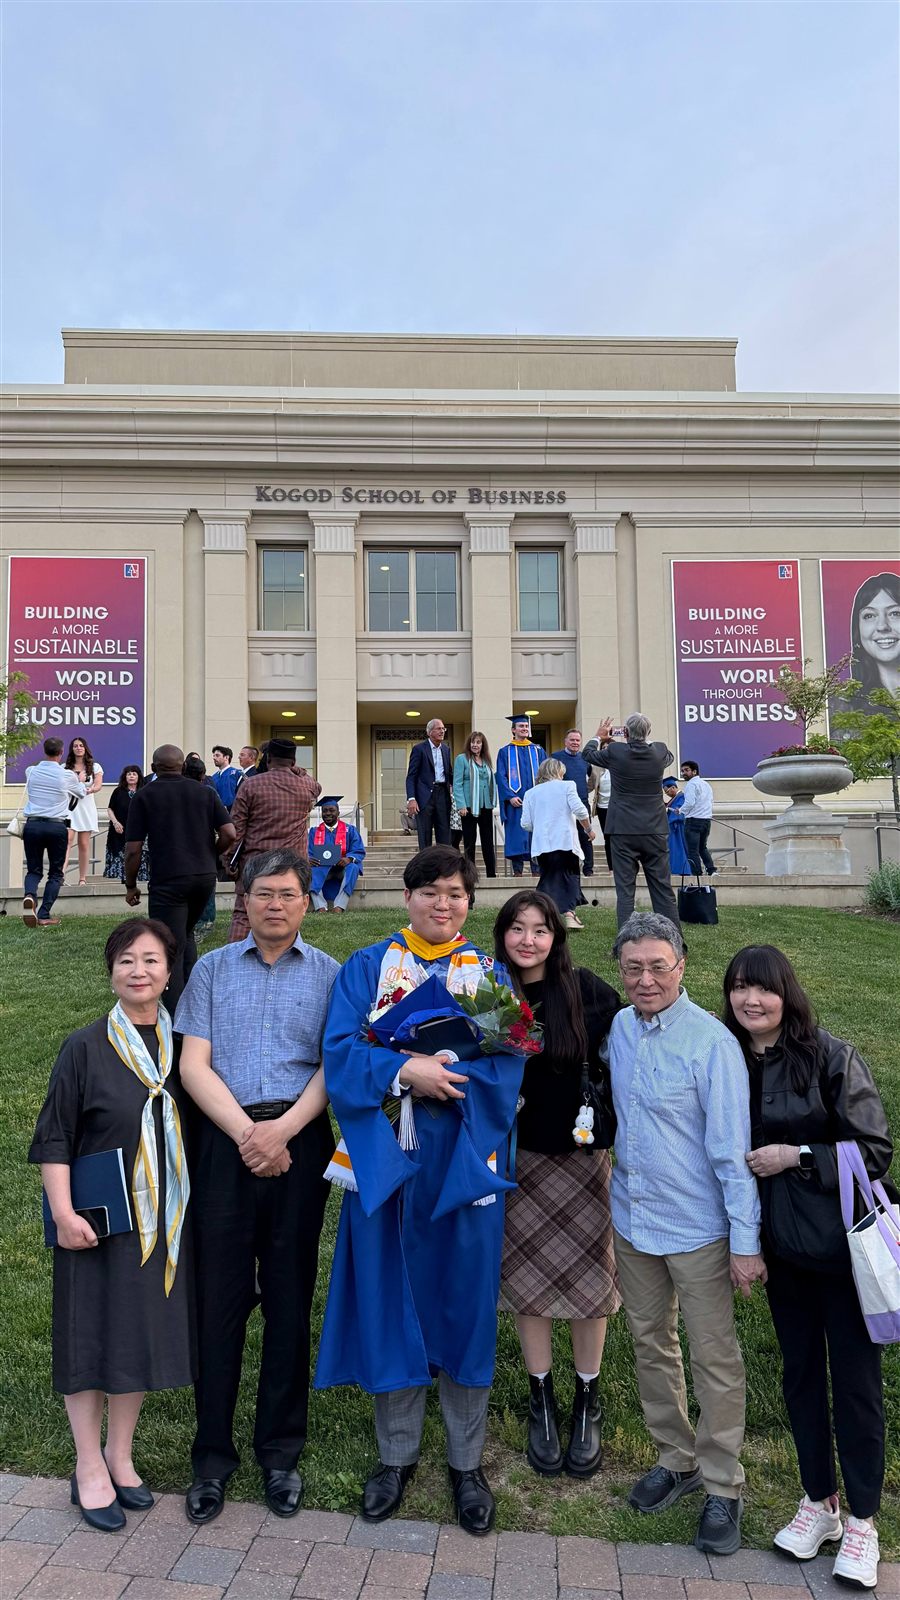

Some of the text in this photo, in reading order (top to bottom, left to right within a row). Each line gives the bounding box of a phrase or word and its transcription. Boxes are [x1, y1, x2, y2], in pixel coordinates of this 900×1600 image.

[255, 485, 567, 505] KOGOD SCHOOL OF BUSINESS
[24, 606, 109, 620] BUILDING
[688, 607, 767, 621] BUILDING
[52, 624, 99, 635] A MORE
[714, 625, 759, 635] A MORE
[14, 638, 138, 656] SUSTAINABLE
[680, 638, 796, 655] SUSTAINABLE
[55, 670, 134, 686] WORLD
[35, 690, 100, 701] THROUGH
[702, 688, 763, 699] THROUGH
[15, 706, 137, 726] BUSINESS
[684, 703, 797, 723] BUSINESS
